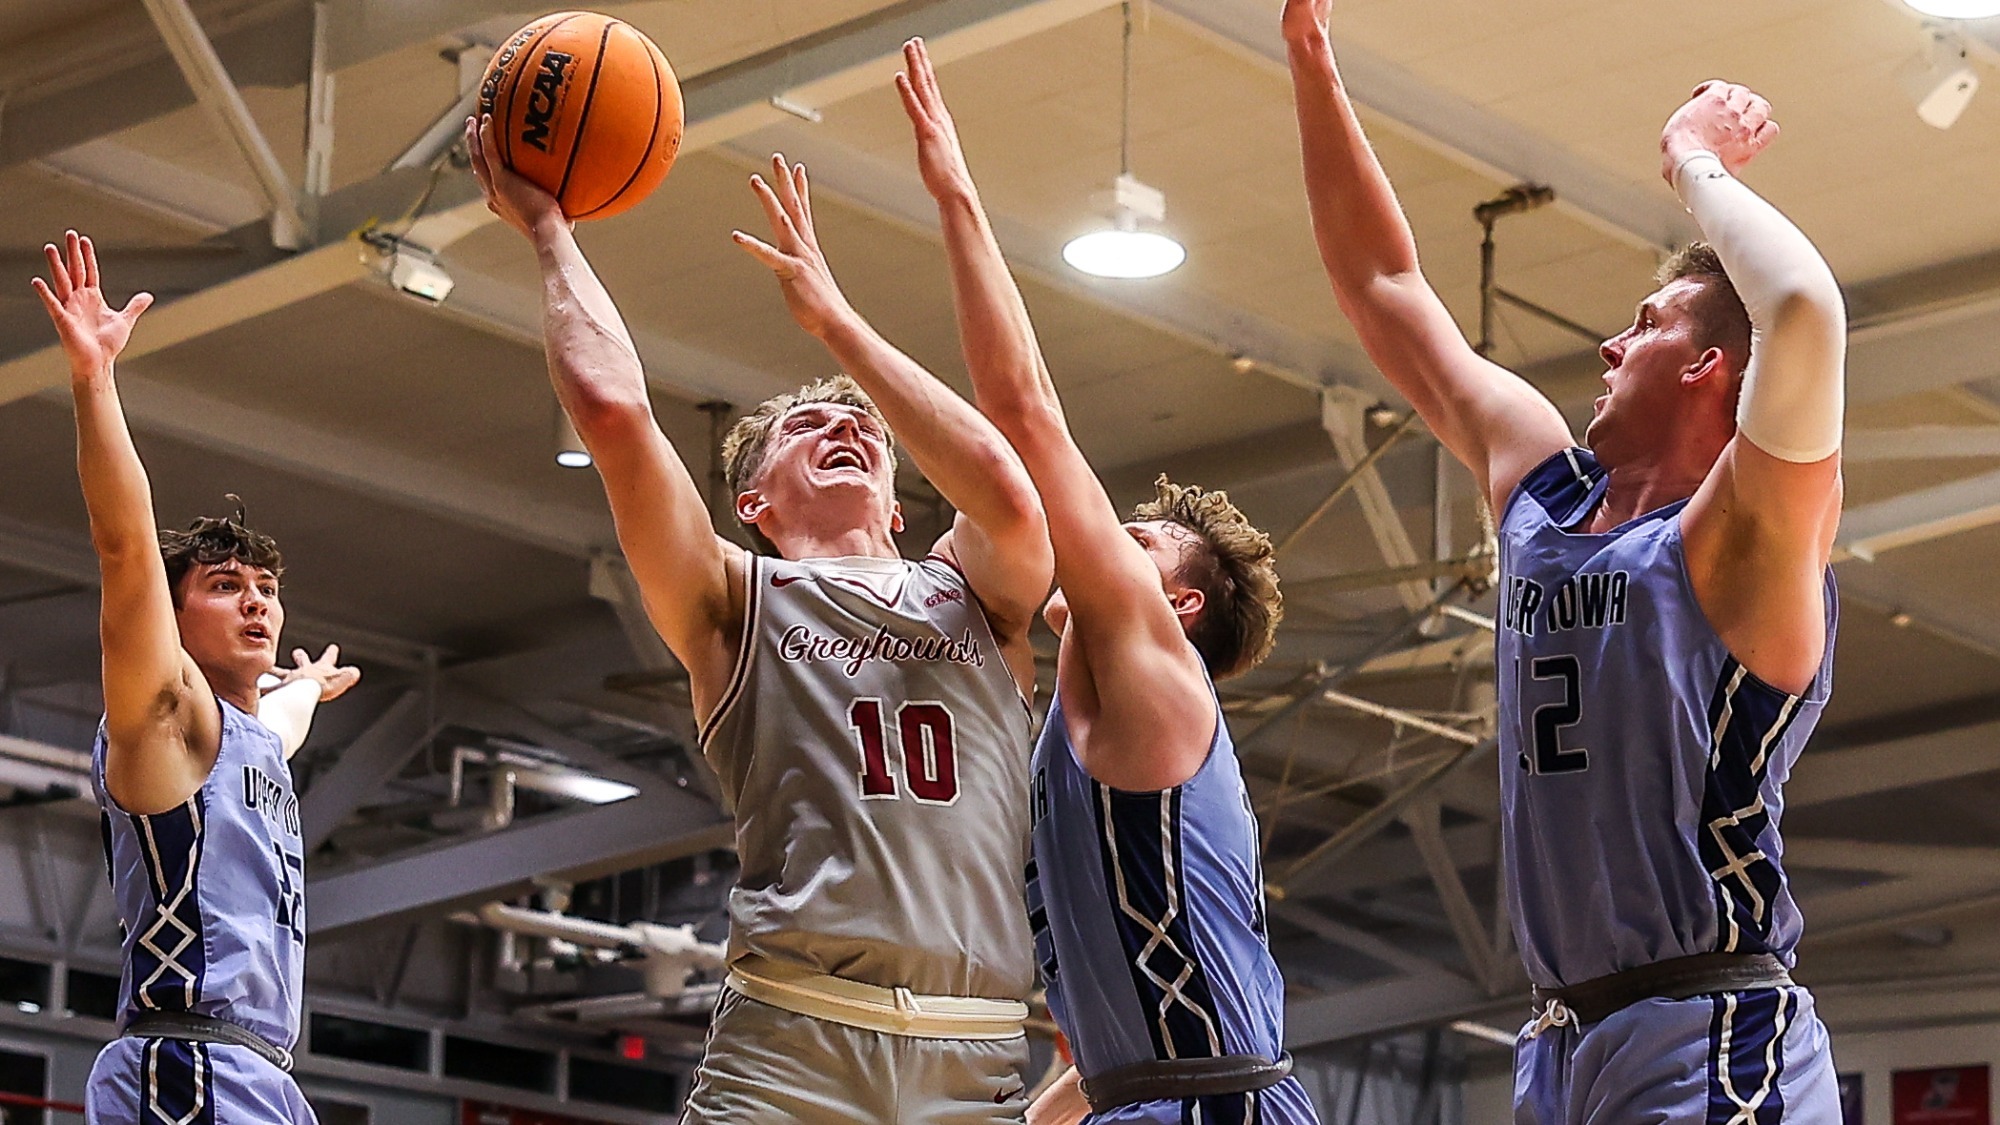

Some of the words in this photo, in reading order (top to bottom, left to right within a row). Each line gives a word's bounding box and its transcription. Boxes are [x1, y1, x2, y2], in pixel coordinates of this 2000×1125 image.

[521, 50, 574, 153] NCAA
[1547, 570, 1630, 633] IOWA
[778, 624, 984, 679] Greyhounds
[846, 696, 962, 807] 10
